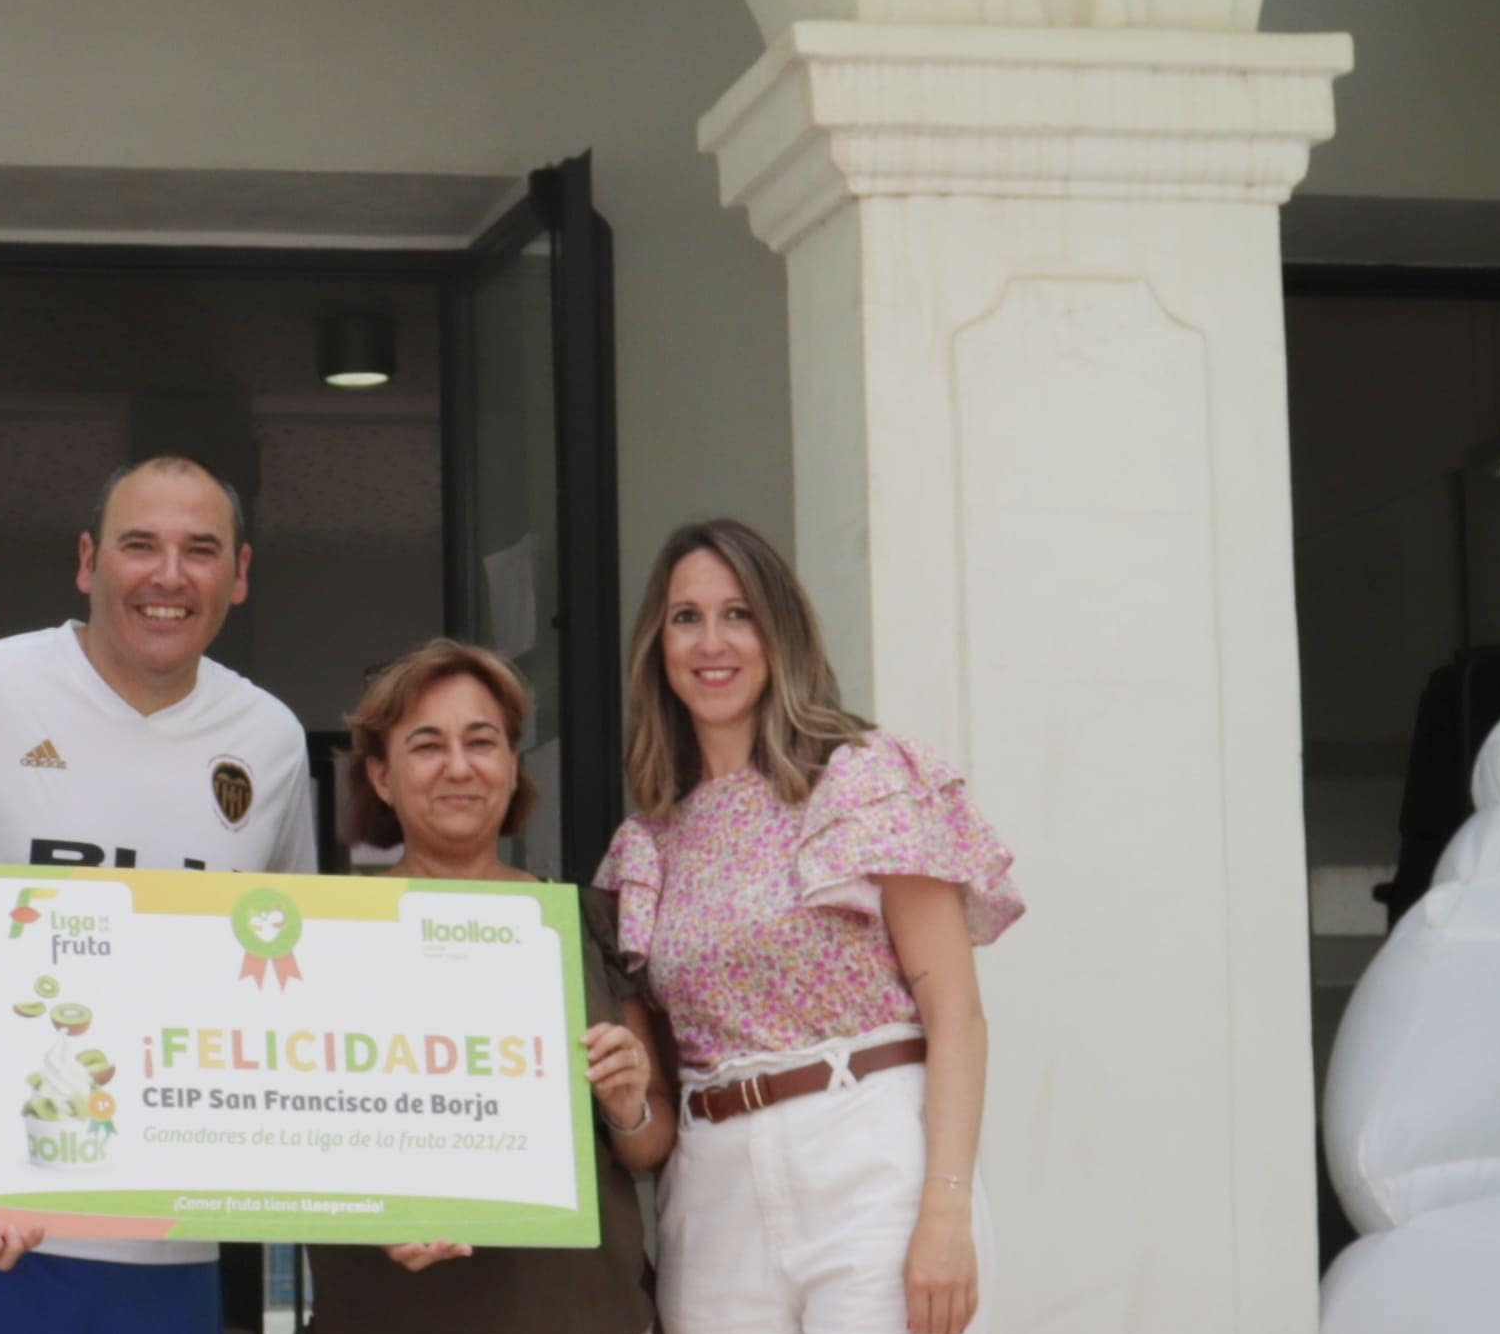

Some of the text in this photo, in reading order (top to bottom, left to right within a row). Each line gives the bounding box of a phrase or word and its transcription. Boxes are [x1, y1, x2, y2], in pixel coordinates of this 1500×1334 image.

[51, 934, 112, 965] fruta
[143, 1027, 545, 1079] ¡FELICIDADES!
[141, 1086, 499, 1122] CEIP San Francisco de Borja
[142, 1125, 248, 1146] Ganadores
[250, 1127, 276, 1146] de
[306, 1129, 345, 1153] liga
[347, 1129, 372, 1148] de
[375, 1130, 396, 1148] la
[398, 1130, 448, 1153] fruta
[451, 1132, 529, 1153] 2021/22
